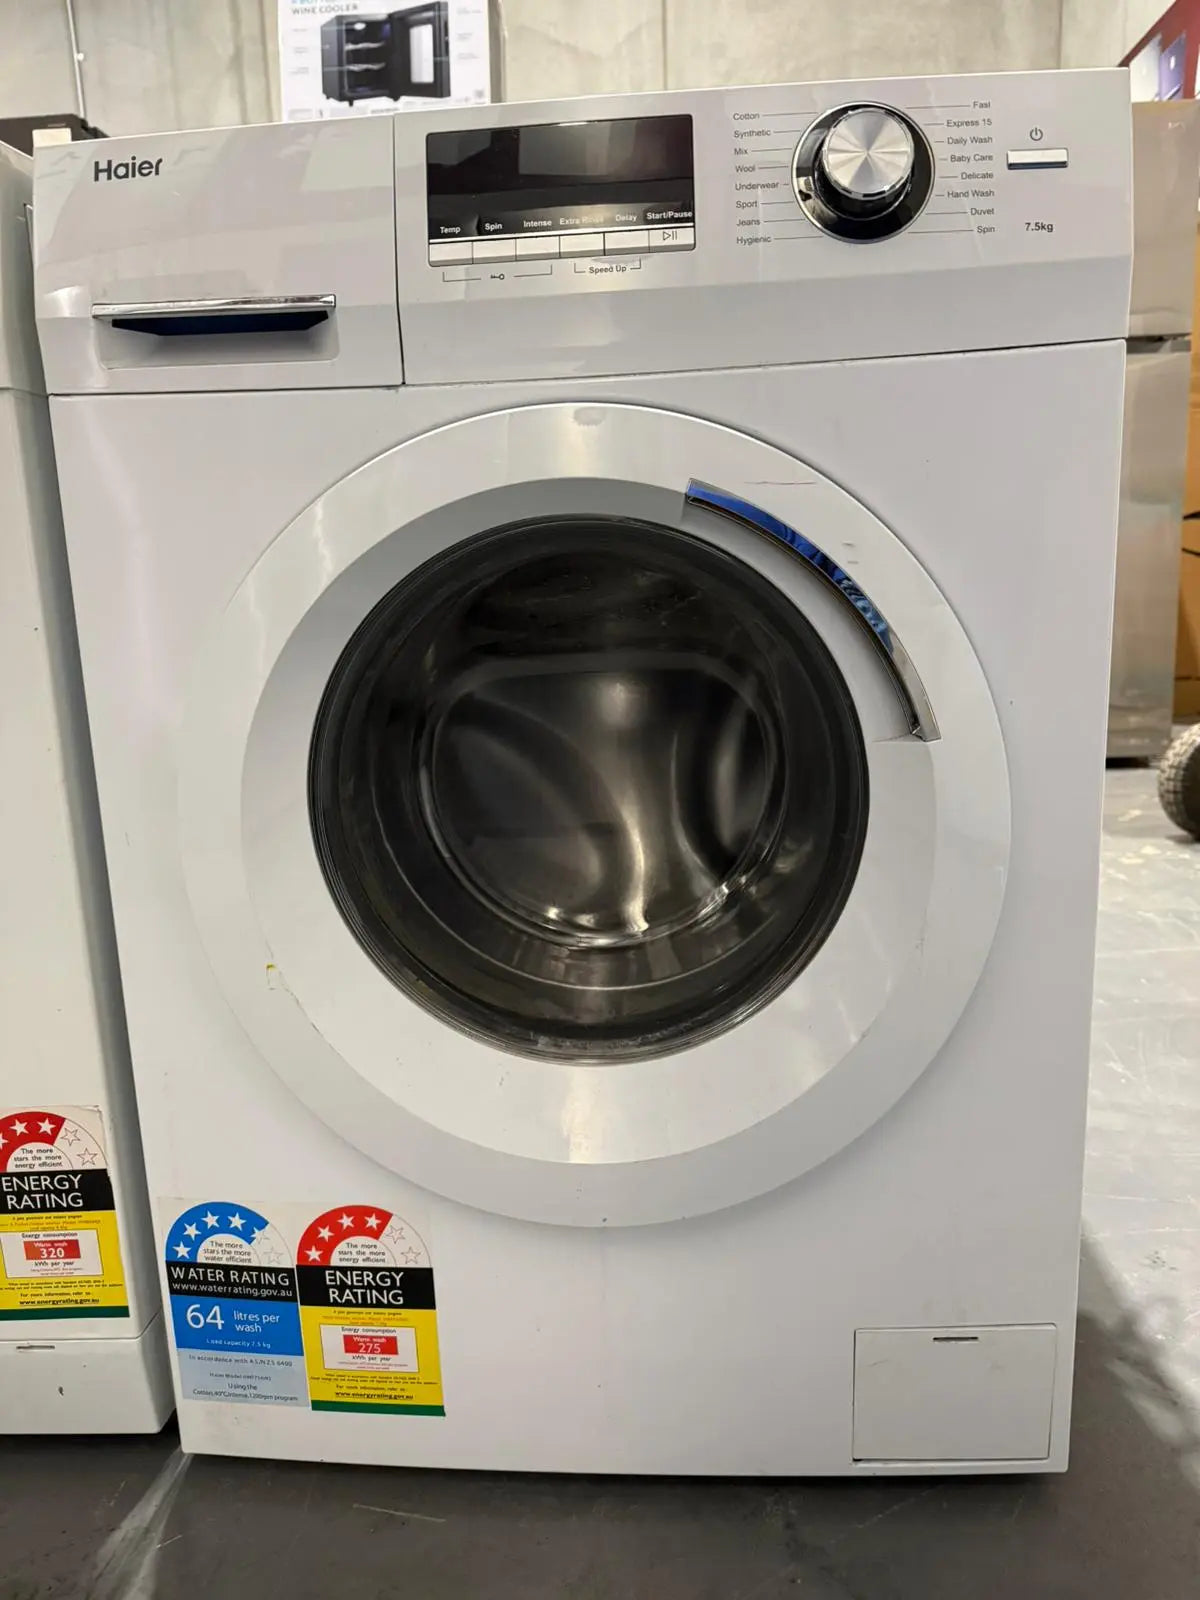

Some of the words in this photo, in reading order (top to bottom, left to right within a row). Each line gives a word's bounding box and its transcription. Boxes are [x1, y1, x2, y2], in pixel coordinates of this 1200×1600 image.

[973, 100, 991, 108] Fast
[732, 112, 760, 120] Cotton
[947, 120, 979, 128] Express
[983, 118, 992, 126] 15
[734, 129, 771, 139] Synthetic
[947, 136, 967, 146] Daily
[969, 136, 992, 144] Wash
[950, 154, 971, 164] Baby
[973, 153, 994, 161] Care
[94, 155, 163, 182] Haier
[960, 171, 994, 180] Delicate
[735, 182, 779, 190] Underwear
[947, 190, 969, 198] Hand
[971, 189, 995, 197] Wash
[736, 200, 758, 209] Sport
[646, 210, 693, 220] Start/Pause
[971, 207, 994, 215] Duvet
[523, 220, 552, 228] Intense
[560, 217, 580, 225] Extra
[440, 226, 461, 234] Temp
[485, 222, 502, 231] Spin
[977, 225, 995, 234] Spin
[1025, 222, 1053, 232] 7.5kg
[736, 236, 772, 246] Hygienic
[589, 266, 614, 275] Speed
[616, 265, 627, 273] Up
[1, 1174, 82, 1192] ENERGY
[6, 1192, 84, 1210] RATING
[40, 1248, 64, 1259] 320
[170, 1266, 225, 1282] WATER
[230, 1270, 289, 1286] RATING
[325, 1270, 404, 1287] ENERGY
[172, 1282, 292, 1297] www.waterrating.gov.au
[329, 1288, 403, 1304] RATING
[186, 1304, 224, 1330] 64
[233, 1309, 260, 1322] litres
[262, 1314, 280, 1324] per
[235, 1323, 262, 1333] wash
[224, 1340, 250, 1348] capacity
[262, 1341, 271, 1349] kg
[358, 1343, 381, 1353] 275
